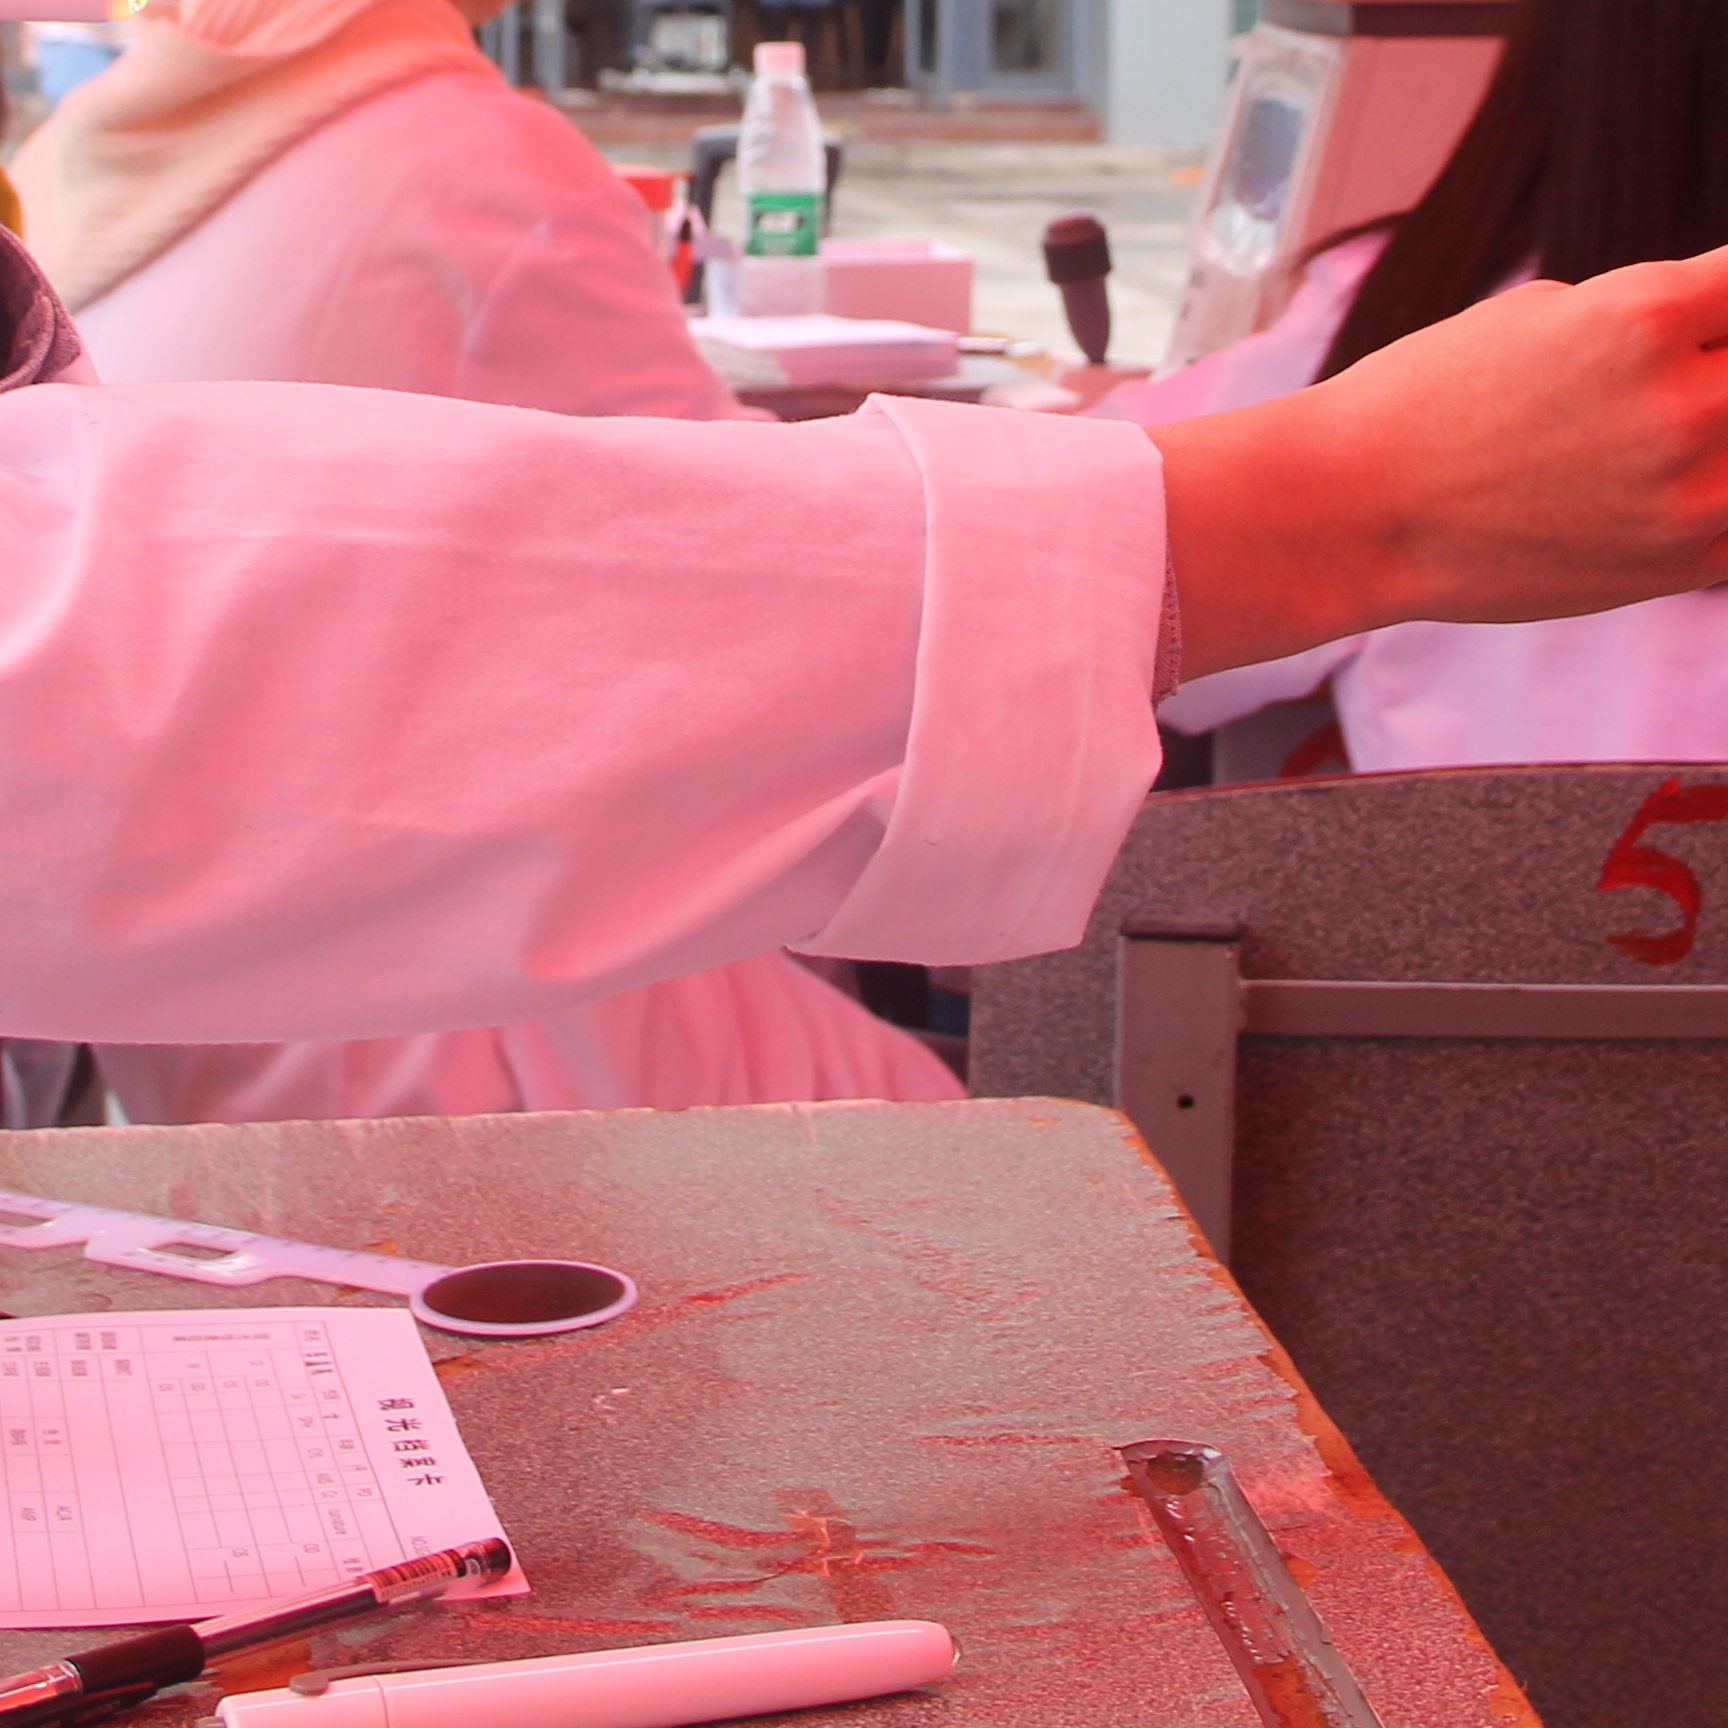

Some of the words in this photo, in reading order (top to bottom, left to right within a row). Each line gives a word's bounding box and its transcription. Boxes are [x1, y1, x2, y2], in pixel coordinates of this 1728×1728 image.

[376, 1397, 445, 1486] 视光档案卡
